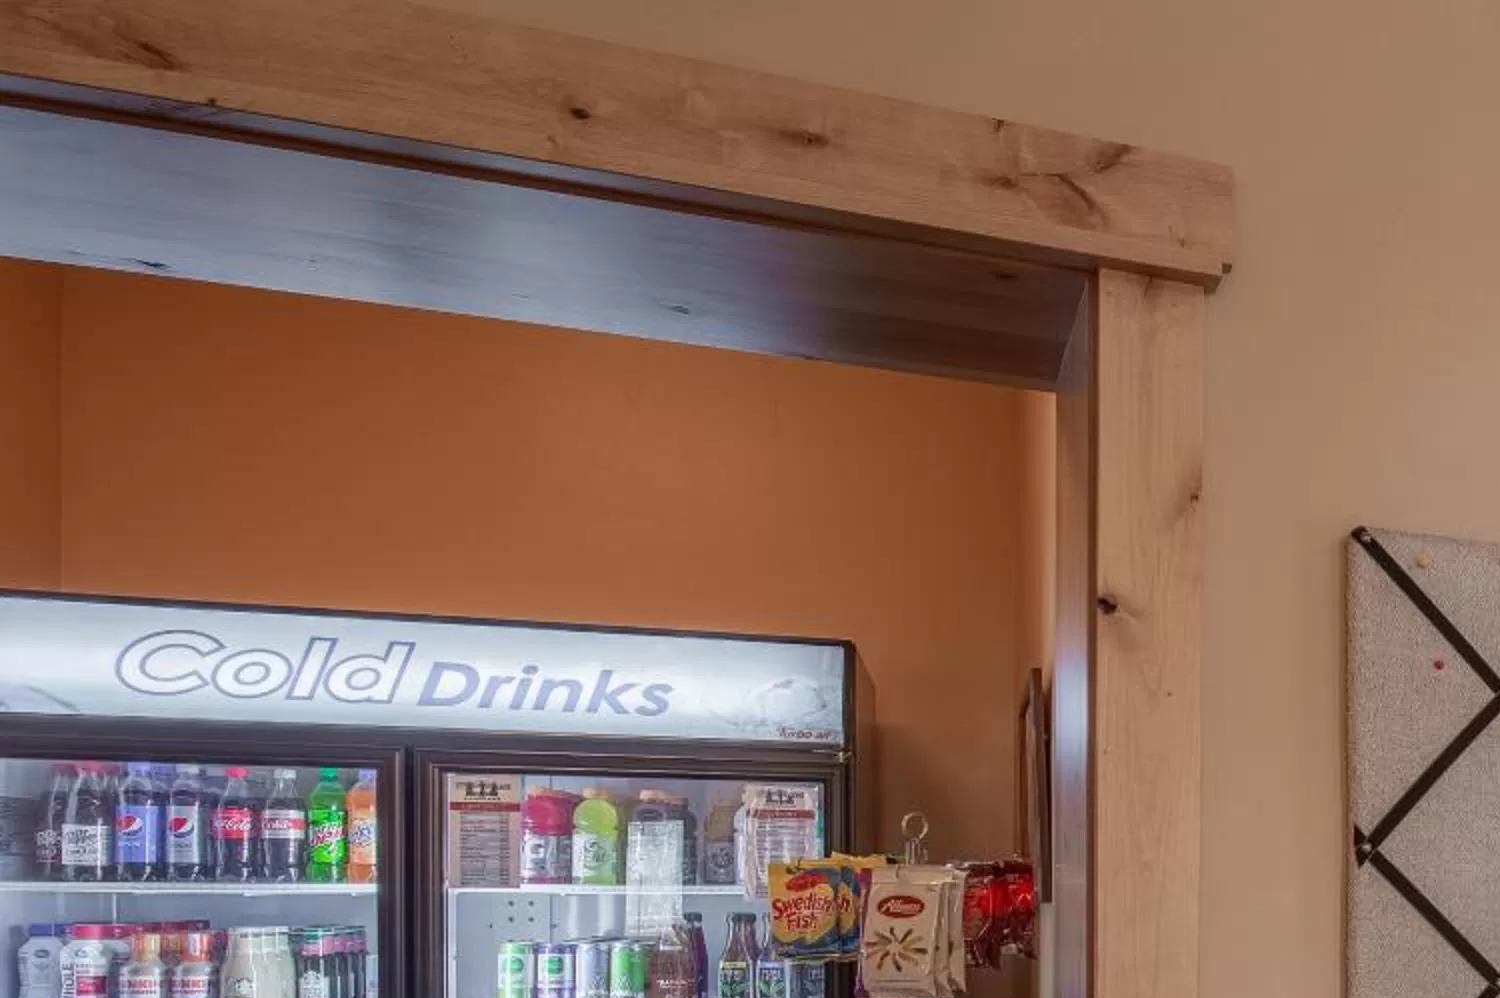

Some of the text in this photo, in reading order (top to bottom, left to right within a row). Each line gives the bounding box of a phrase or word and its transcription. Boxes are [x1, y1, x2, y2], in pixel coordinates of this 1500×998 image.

[116, 629, 674, 717] Cold Drinks
[772, 892, 832, 920] Swedish
[787, 911, 818, 931] Fish
